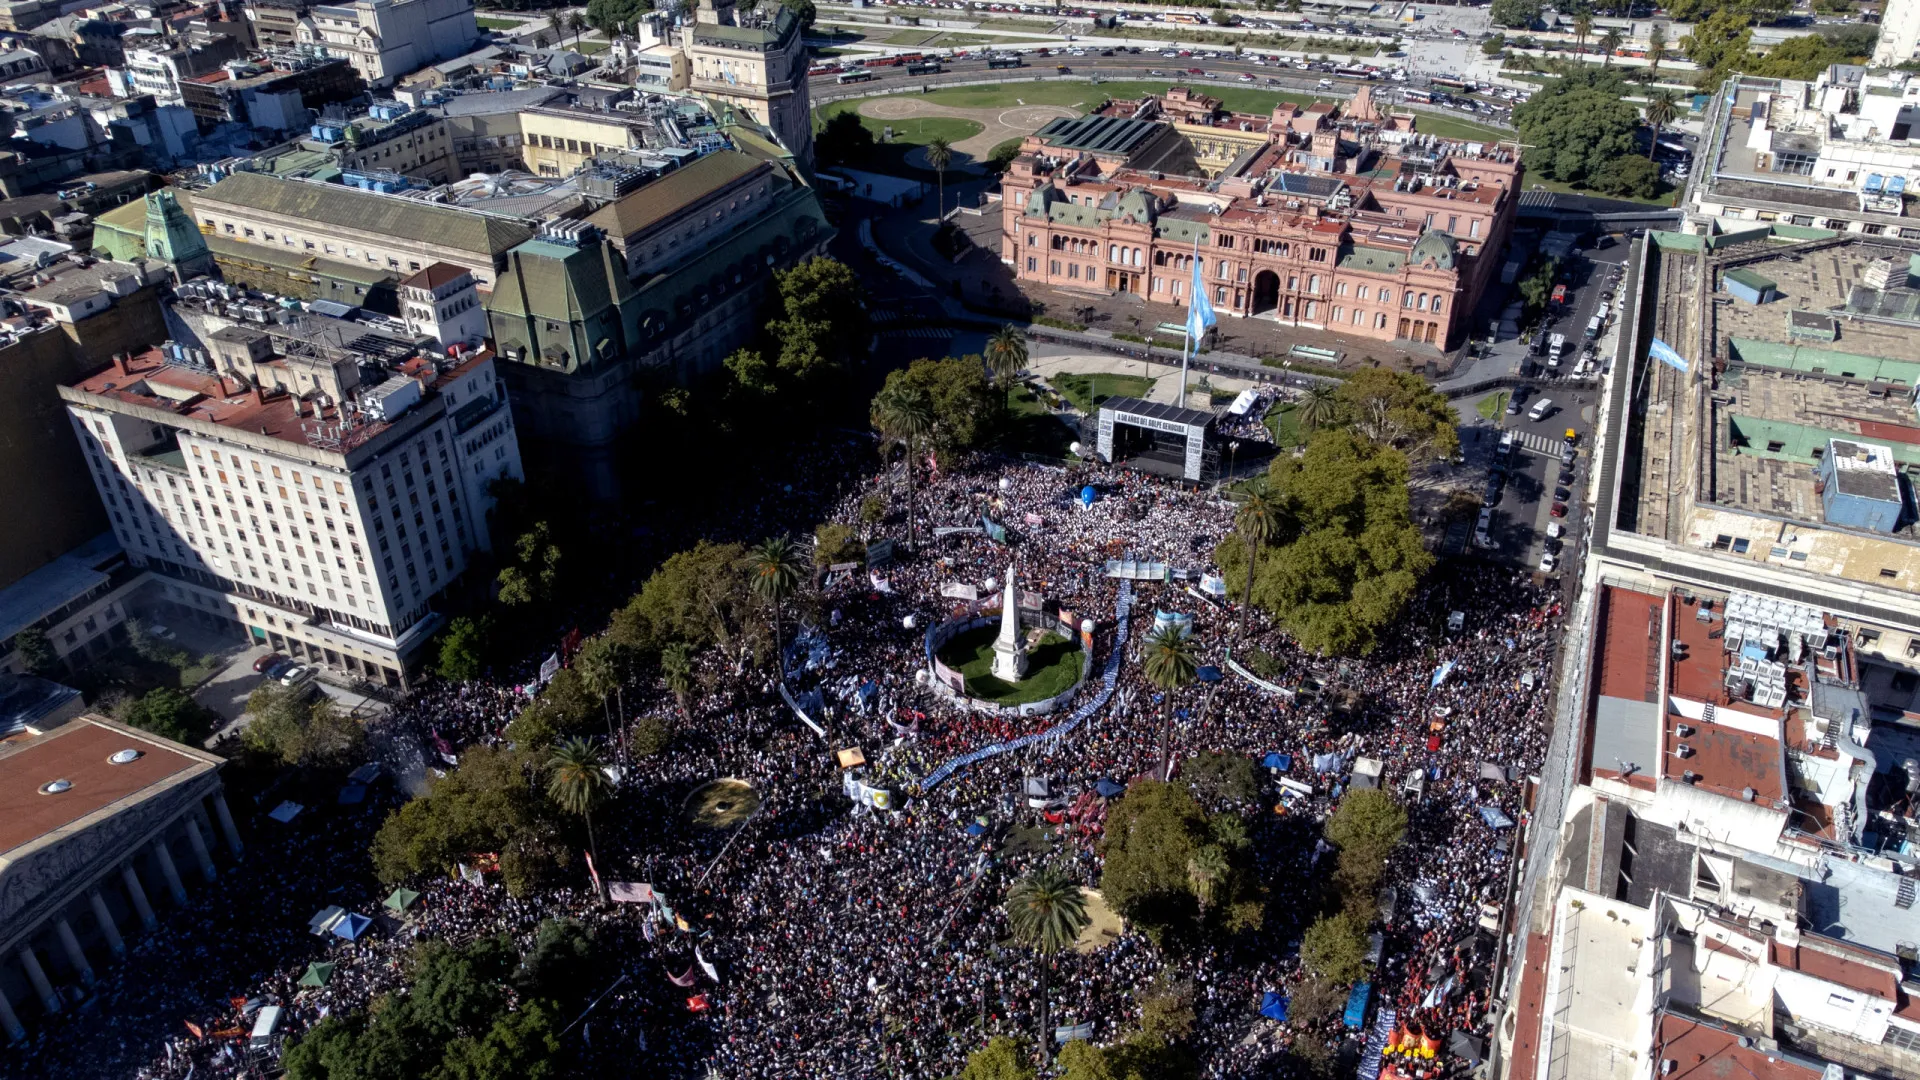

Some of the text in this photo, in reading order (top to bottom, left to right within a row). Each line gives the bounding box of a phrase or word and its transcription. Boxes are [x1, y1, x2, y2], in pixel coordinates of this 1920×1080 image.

[1128, 414, 1139, 424] AÑOS
[1148, 419, 1162, 428] GOLPE
[1162, 422, 1184, 432] GENOCIDA
